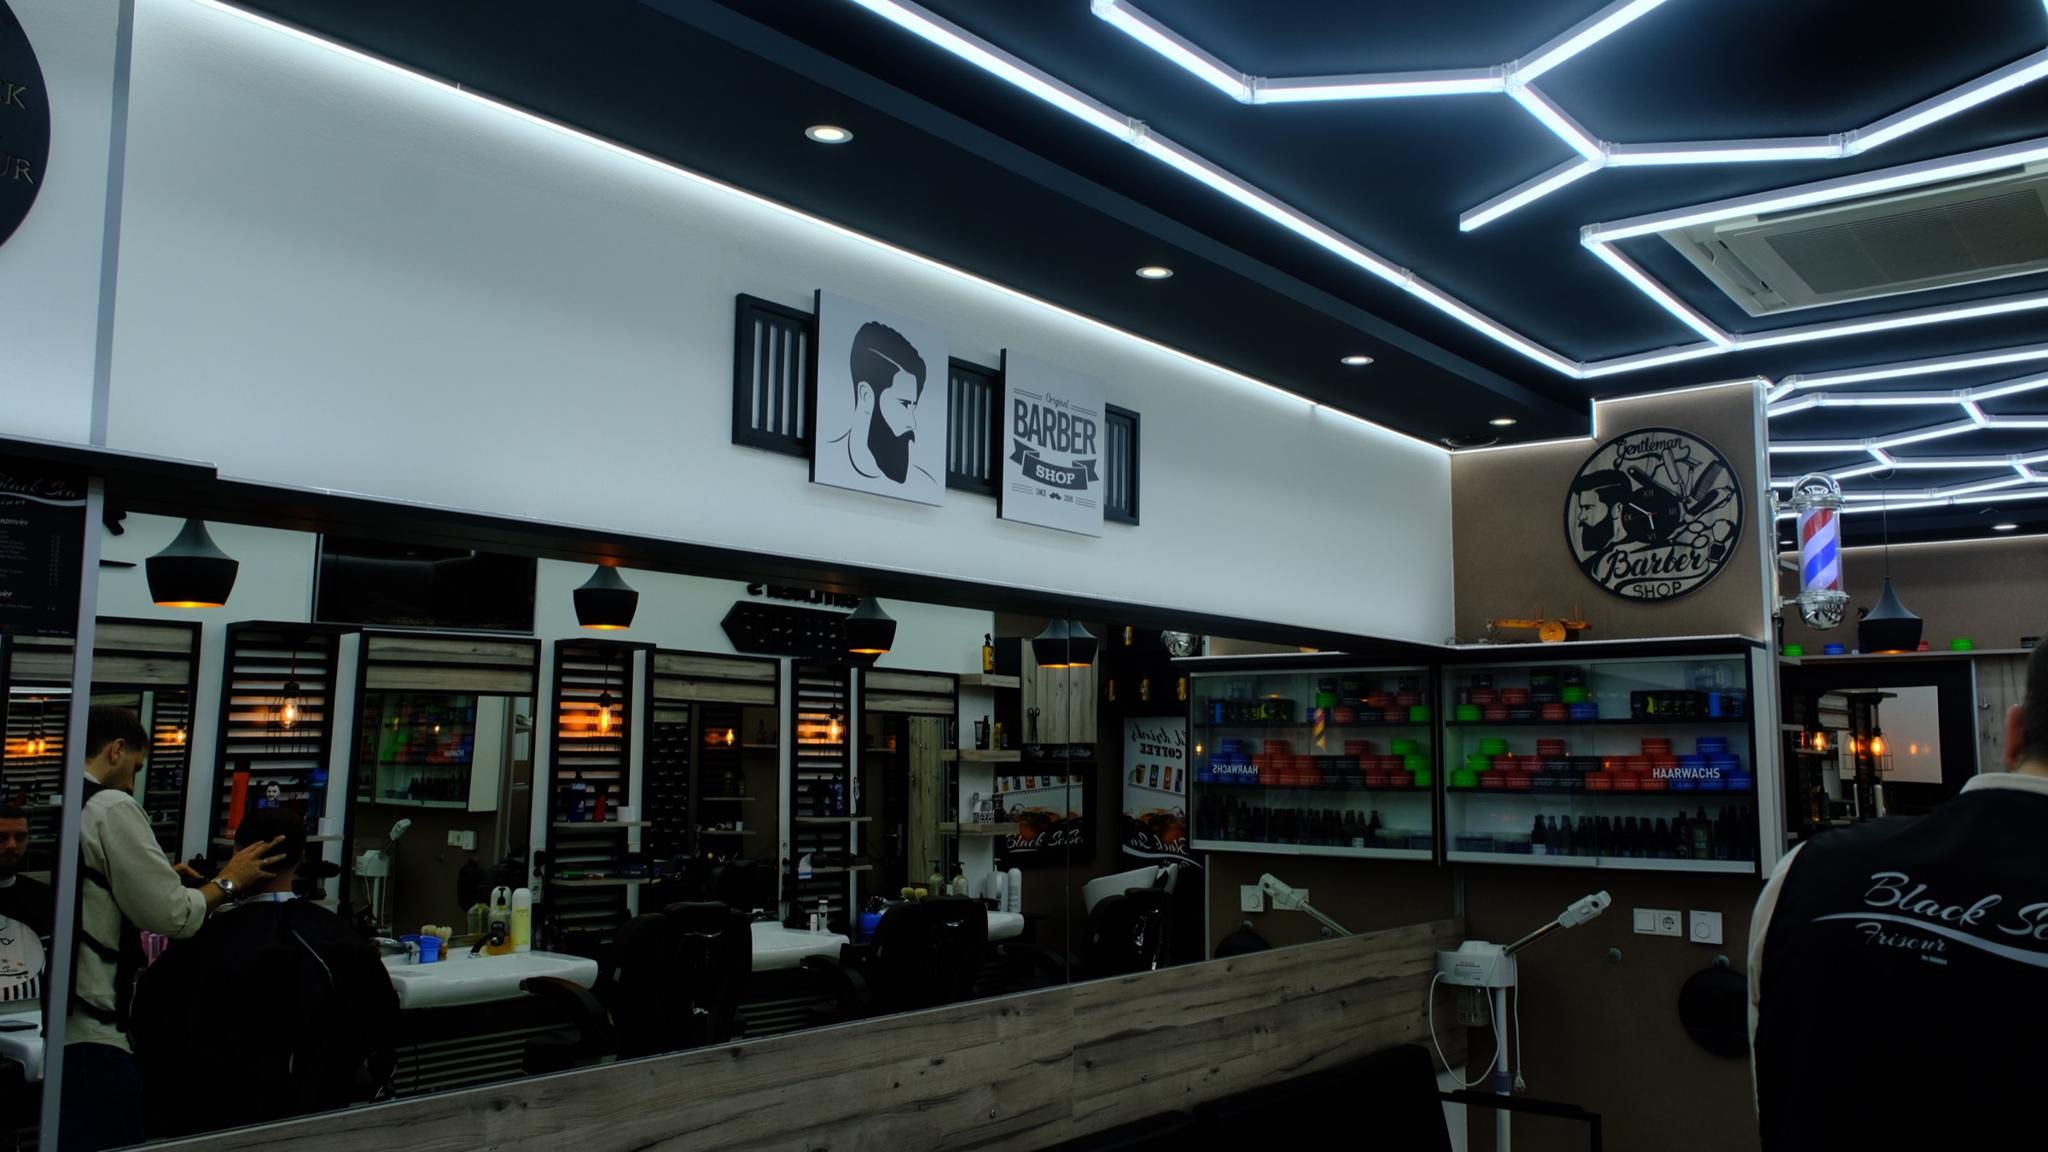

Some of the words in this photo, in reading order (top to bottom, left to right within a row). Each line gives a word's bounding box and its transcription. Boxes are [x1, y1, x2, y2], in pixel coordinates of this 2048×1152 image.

[1013, 398, 1097, 455] BARBER
[1615, 437, 1684, 462] Gentleman
[1035, 464, 1076, 485] SHOP
[1602, 548, 1704, 583] Barber
[1632, 581, 1682, 599] SHOP
[1652, 767, 1720, 780] HAARWACHS
[1005, 832, 1047, 849] Black
[1863, 871, 2003, 927] Black
[1855, 921, 1950, 952] Friseur
